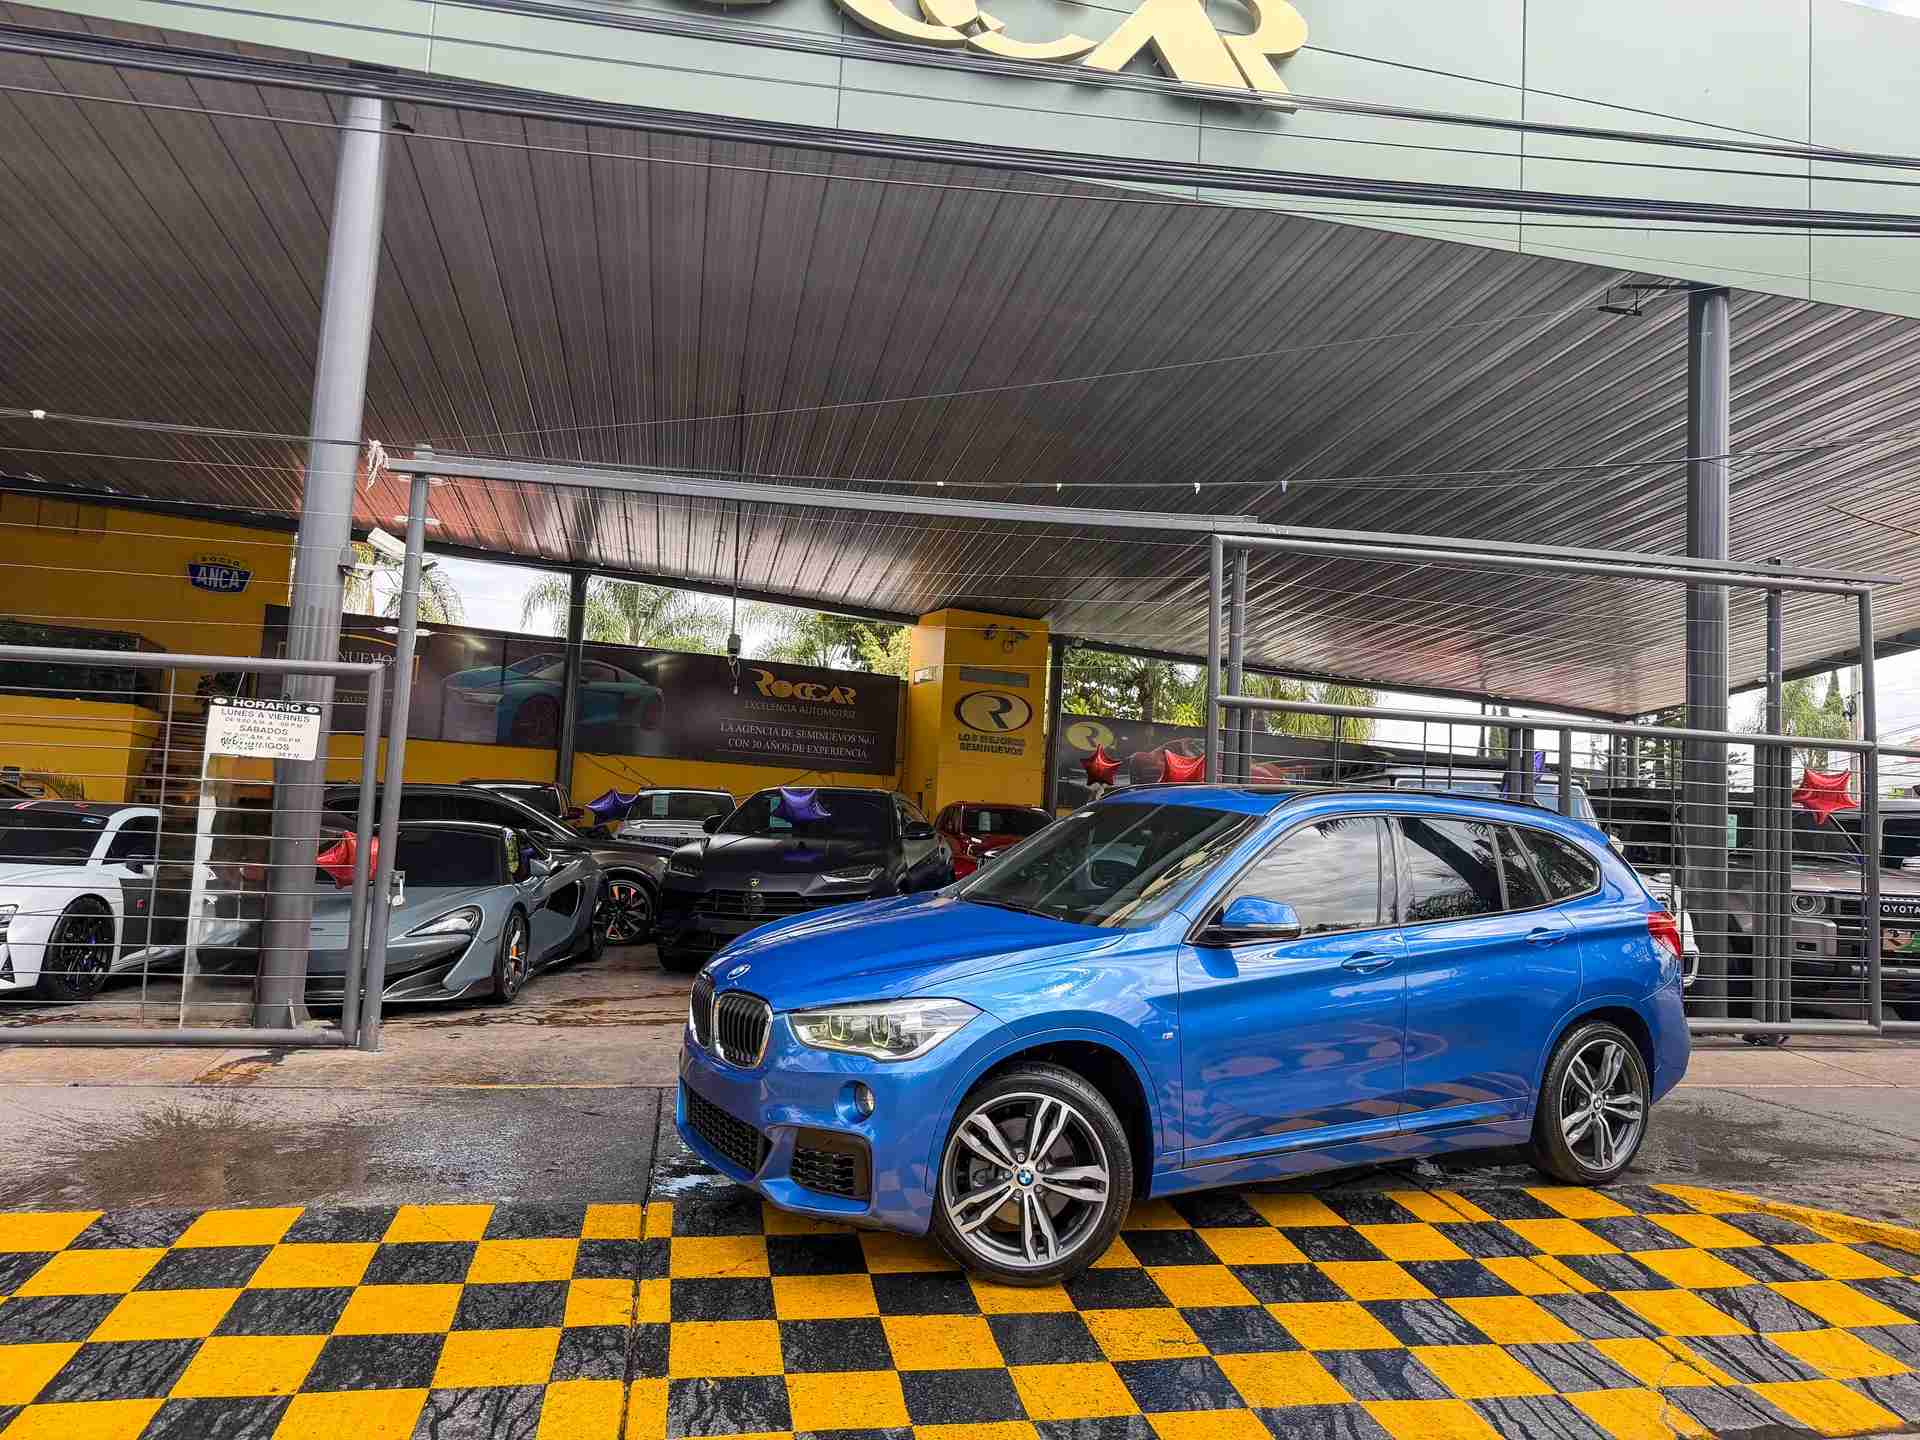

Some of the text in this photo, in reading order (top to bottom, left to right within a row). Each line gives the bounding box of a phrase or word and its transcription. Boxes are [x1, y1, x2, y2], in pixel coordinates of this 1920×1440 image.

[198, 566, 240, 589] ANCA
[748, 667, 857, 705] ROCCAR
[222, 708, 255, 717] LUNES
[258, 711, 265, 719] A
[269, 713, 310, 723] VIERNES
[233, 699, 301, 712] HORARIO
[720, 722, 734, 733] LA
[735, 724, 779, 737] AGENCIA
[781, 728, 795, 738] DE
[796, 729, 856, 744] SEMINUEVOS
[728, 737, 750, 747] CON
[792, 743, 805, 753] DE
[807, 744, 867, 759] EXPERIENCIA
[1880, 904, 1920, 914] OYOTA
